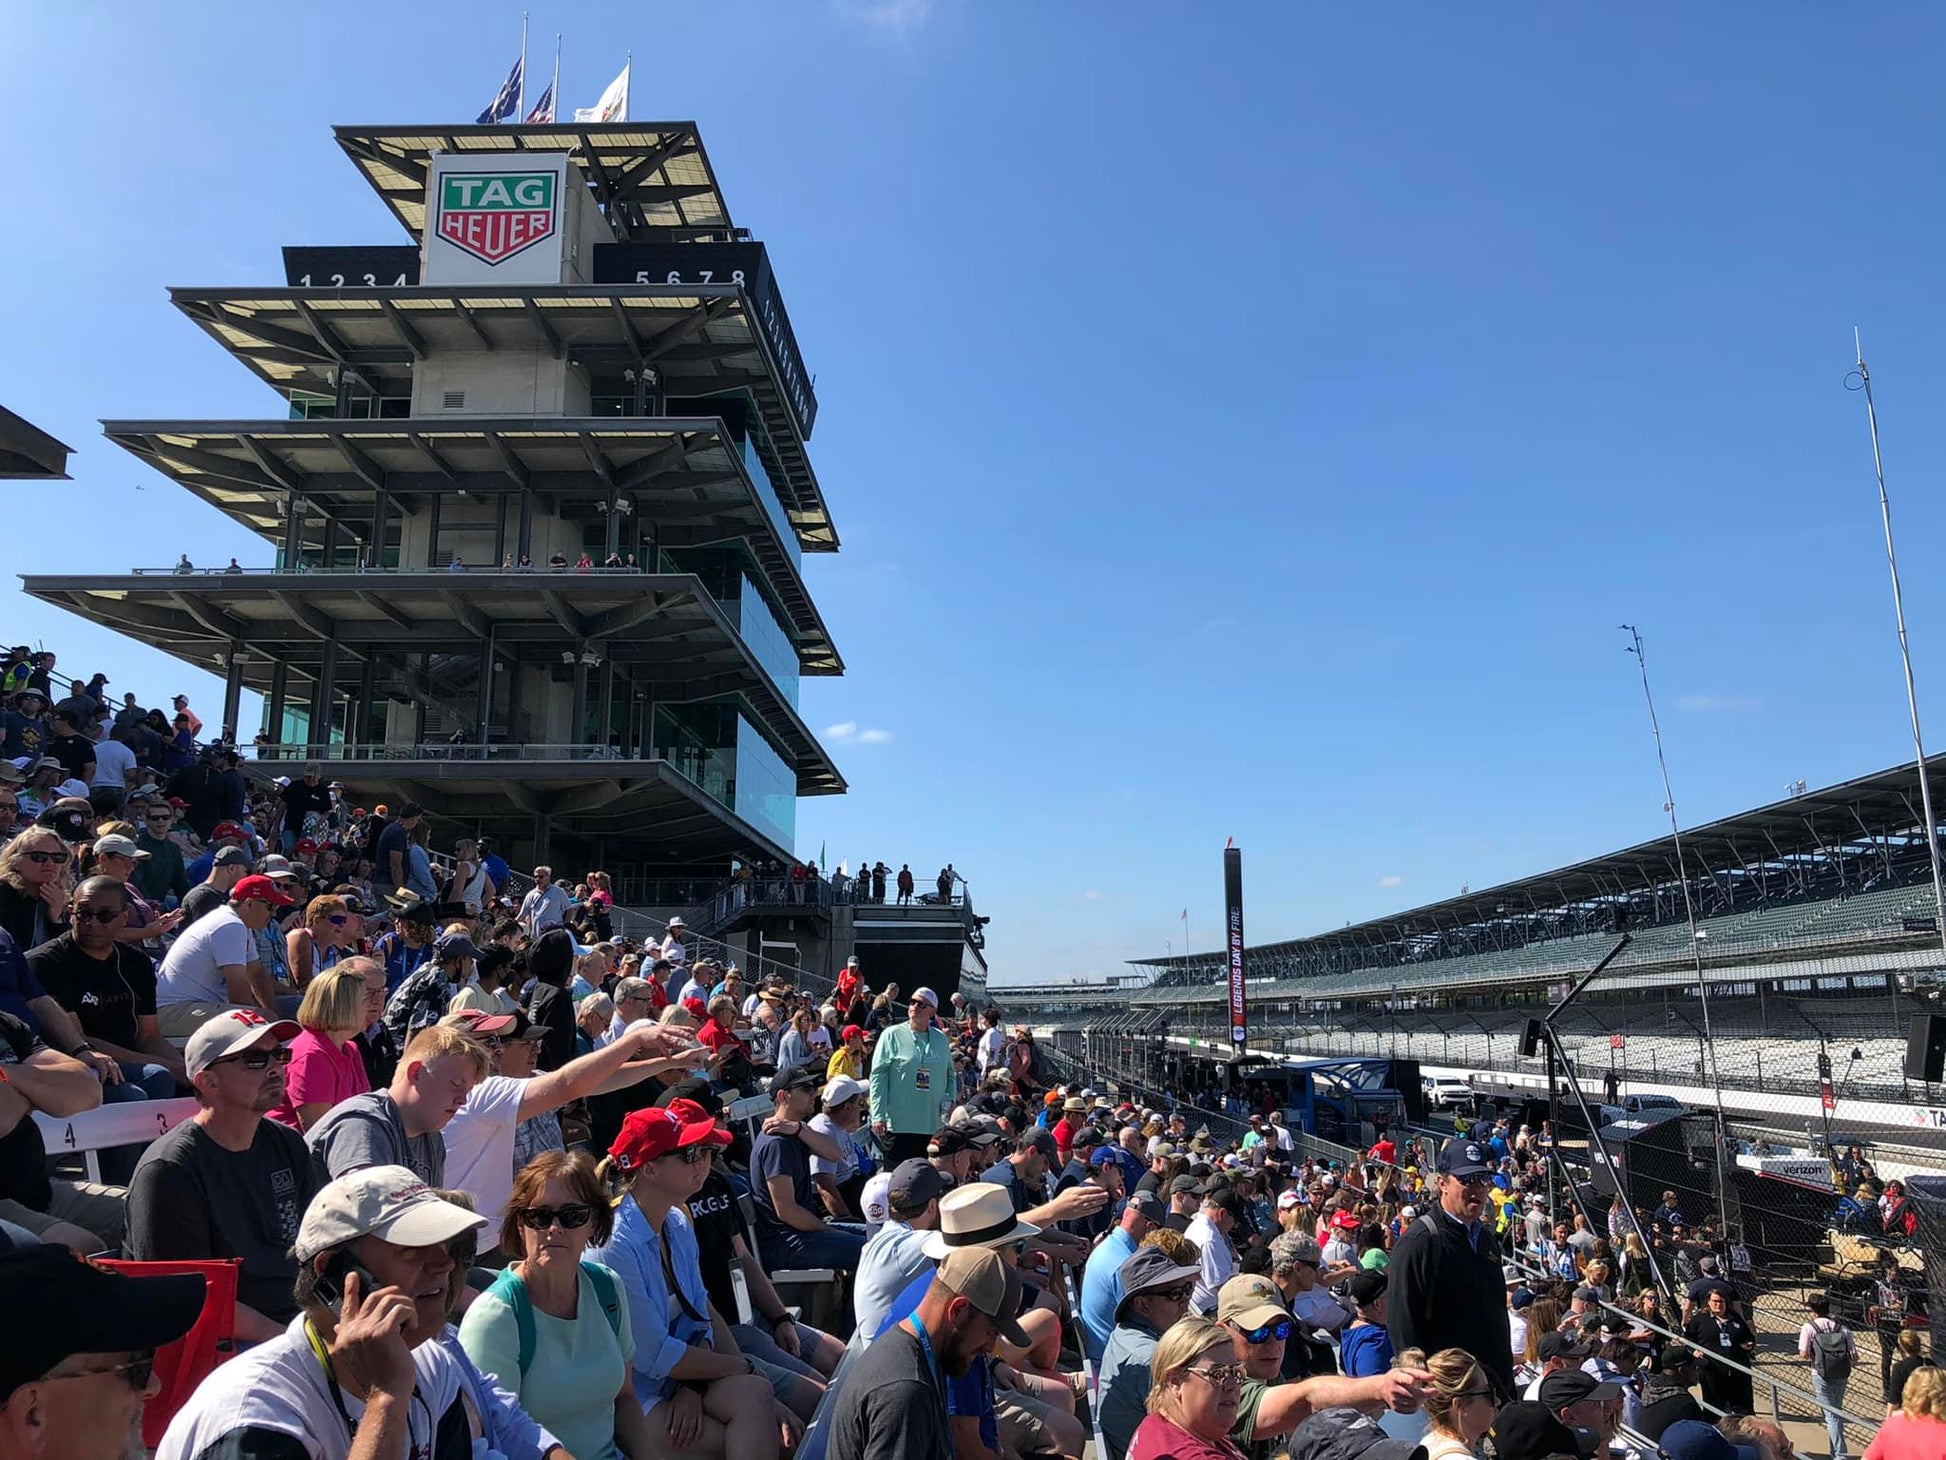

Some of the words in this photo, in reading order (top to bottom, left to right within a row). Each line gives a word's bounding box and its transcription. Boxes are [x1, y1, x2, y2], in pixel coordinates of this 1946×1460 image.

[451, 179, 544, 207] TAG
[445, 213, 546, 256] HEUER
[636, 271, 650, 285] 5
[667, 270, 681, 285] 6
[699, 271, 714, 285] 7
[731, 270, 746, 288] 8
[1231, 932, 1241, 946] BY
[1232, 947, 1242, 967] DAY
[1232, 968, 1243, 1014] LEGENDS
[64, 1122, 76, 1149] 4
[156, 1113, 169, 1136] 3
[620, 1154, 631, 1169] 8
[1784, 1164, 1822, 1175] verizon
